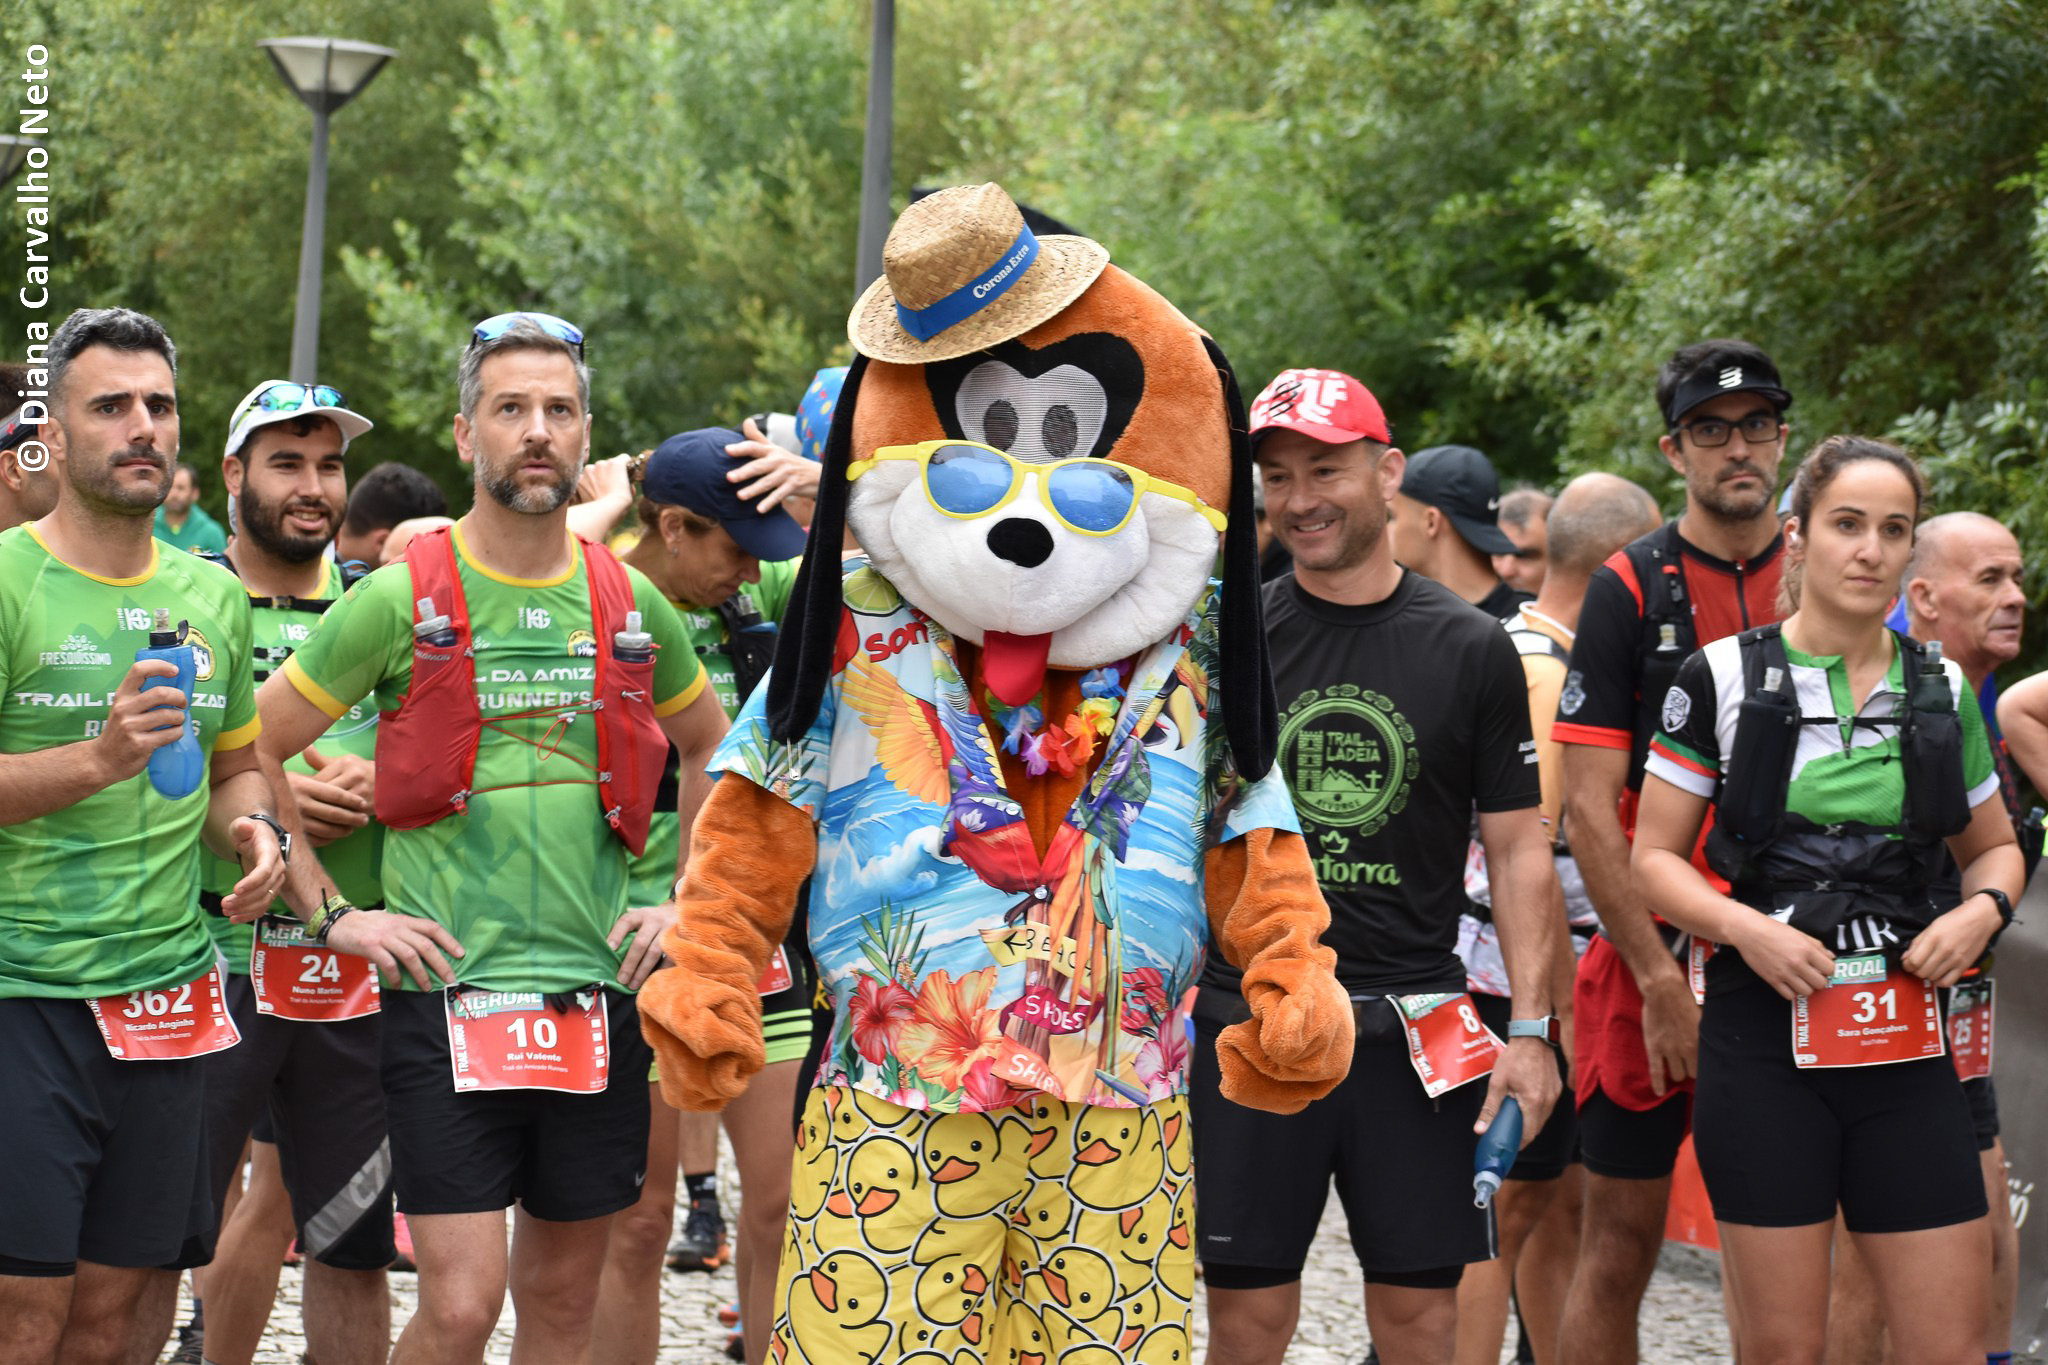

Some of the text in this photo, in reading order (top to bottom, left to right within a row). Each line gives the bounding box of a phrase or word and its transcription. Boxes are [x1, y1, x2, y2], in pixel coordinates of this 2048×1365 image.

[973, 244, 1029, 298] Corona Extra
[491, 669, 528, 683] DA
[531, 667, 596, 682] AMIZ
[14, 692, 103, 707] TRAIL
[1326, 732, 1364, 747] TRAIL
[1326, 747, 1381, 762] LADEIA
[298, 953, 341, 983] 24
[1834, 959, 1886, 978] ROAL
[89, 998, 103, 1018] LON
[122, 983, 194, 1018] 362
[1852, 988, 1896, 1023] 31
[1026, 994, 1088, 1031] SHOES
[124, 1018, 195, 1033] Ricardo Anginho
[506, 1017, 558, 1049] 10
[1797, 1023, 1809, 1048] TRAIL
[1837, 1024, 1909, 1037] Sara Gonçalves
[453, 1023, 469, 1073] TRAIL LONGO
[506, 1051, 562, 1062] Rui Valente
